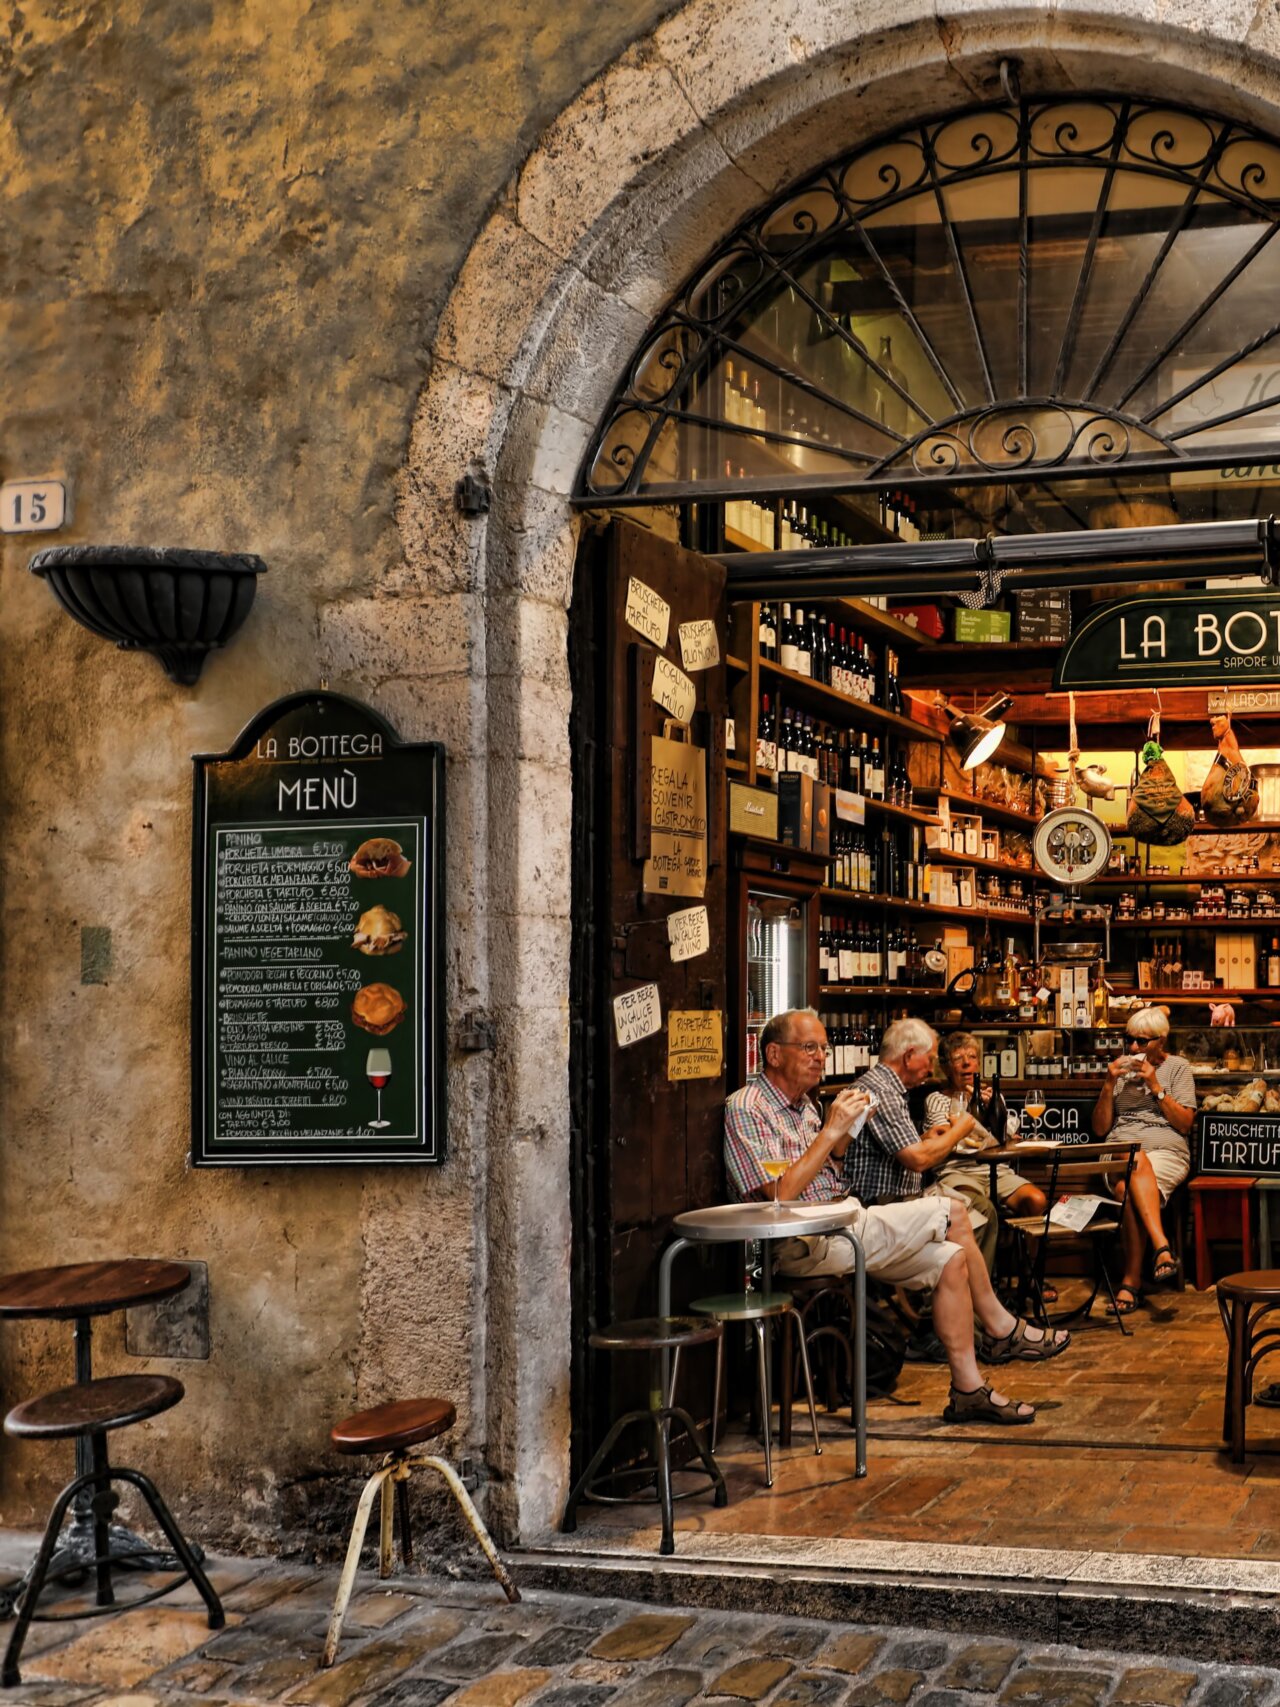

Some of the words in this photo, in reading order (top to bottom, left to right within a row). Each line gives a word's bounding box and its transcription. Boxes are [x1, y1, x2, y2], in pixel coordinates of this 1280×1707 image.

[13, 493, 47, 524] 15
[628, 605, 662, 642] TARTUFO
[1120, 615, 1166, 659] LA
[1224, 656, 1267, 669] SAPORE
[661, 691, 685, 719] MULO
[256, 738, 277, 759] LA
[288, 733, 383, 758] BOTTEGA
[278, 768, 357, 812] MENÙ
[260, 946, 323, 959] VEGETARIANO
